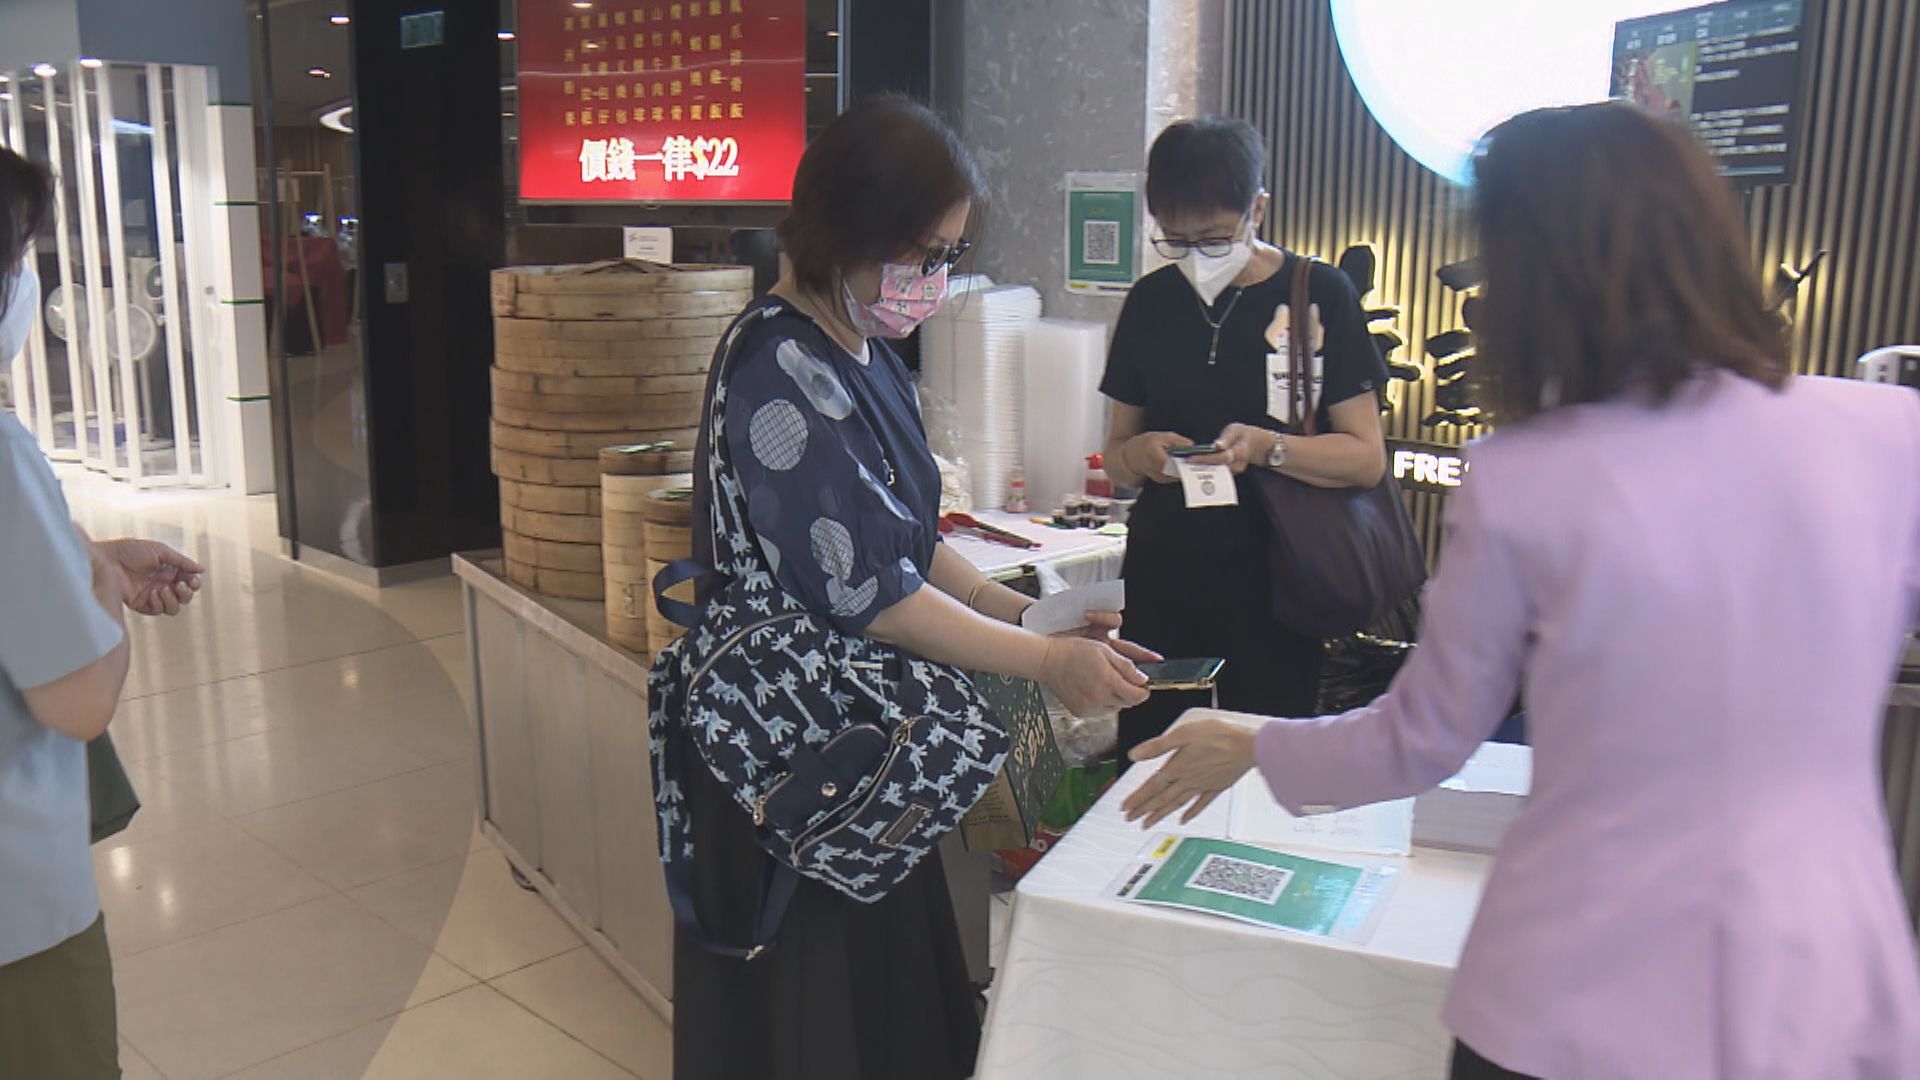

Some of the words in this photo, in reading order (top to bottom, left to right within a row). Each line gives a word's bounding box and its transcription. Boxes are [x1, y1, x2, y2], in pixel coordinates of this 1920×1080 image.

[579, 135, 739, 182] 價錢一律$22
[1393, 450, 1470, 486] FRE
